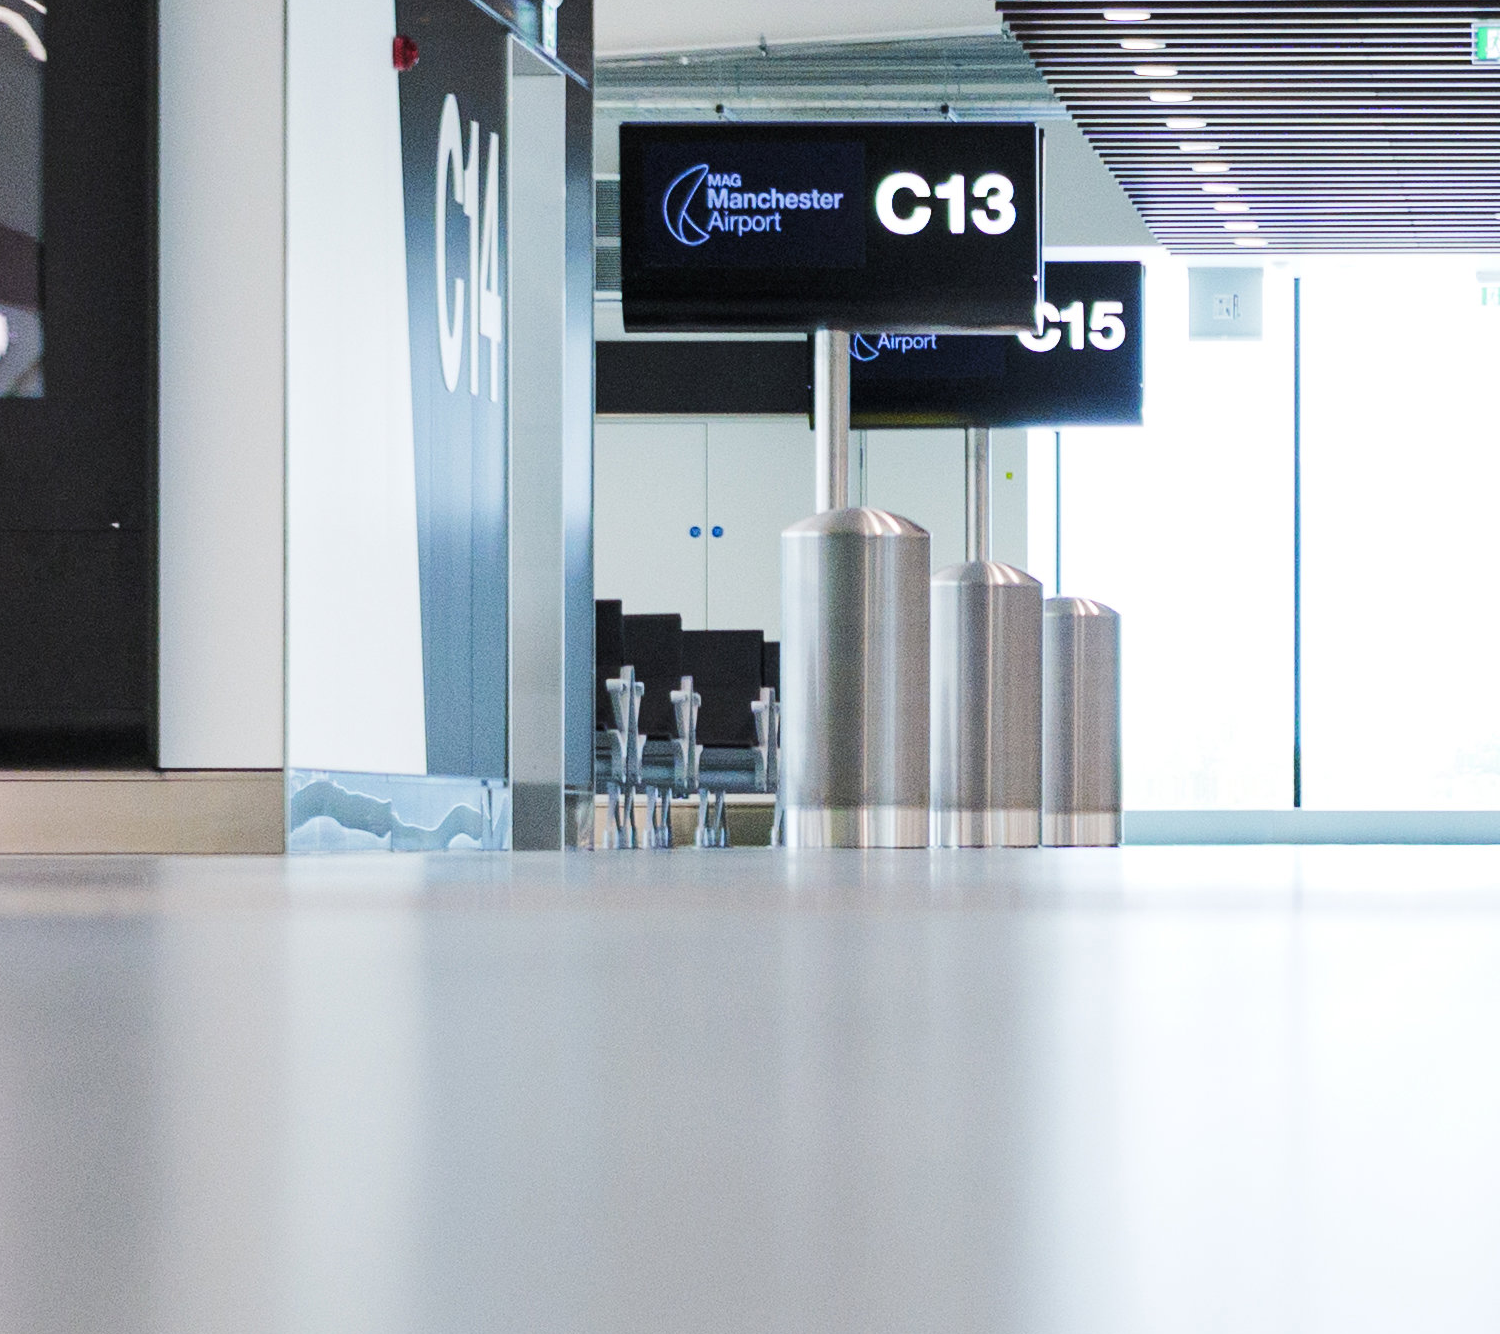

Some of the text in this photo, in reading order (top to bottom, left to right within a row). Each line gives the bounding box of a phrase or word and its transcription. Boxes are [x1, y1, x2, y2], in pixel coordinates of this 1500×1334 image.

[707, 173, 743, 188] MAG
[706, 187, 844, 210] Manchester
[875, 171, 1017, 235] C13
[707, 211, 782, 236] Airport
[436, 94, 503, 402] C14
[1017, 301, 1126, 353] C15
[877, 334, 937, 354] Airport
